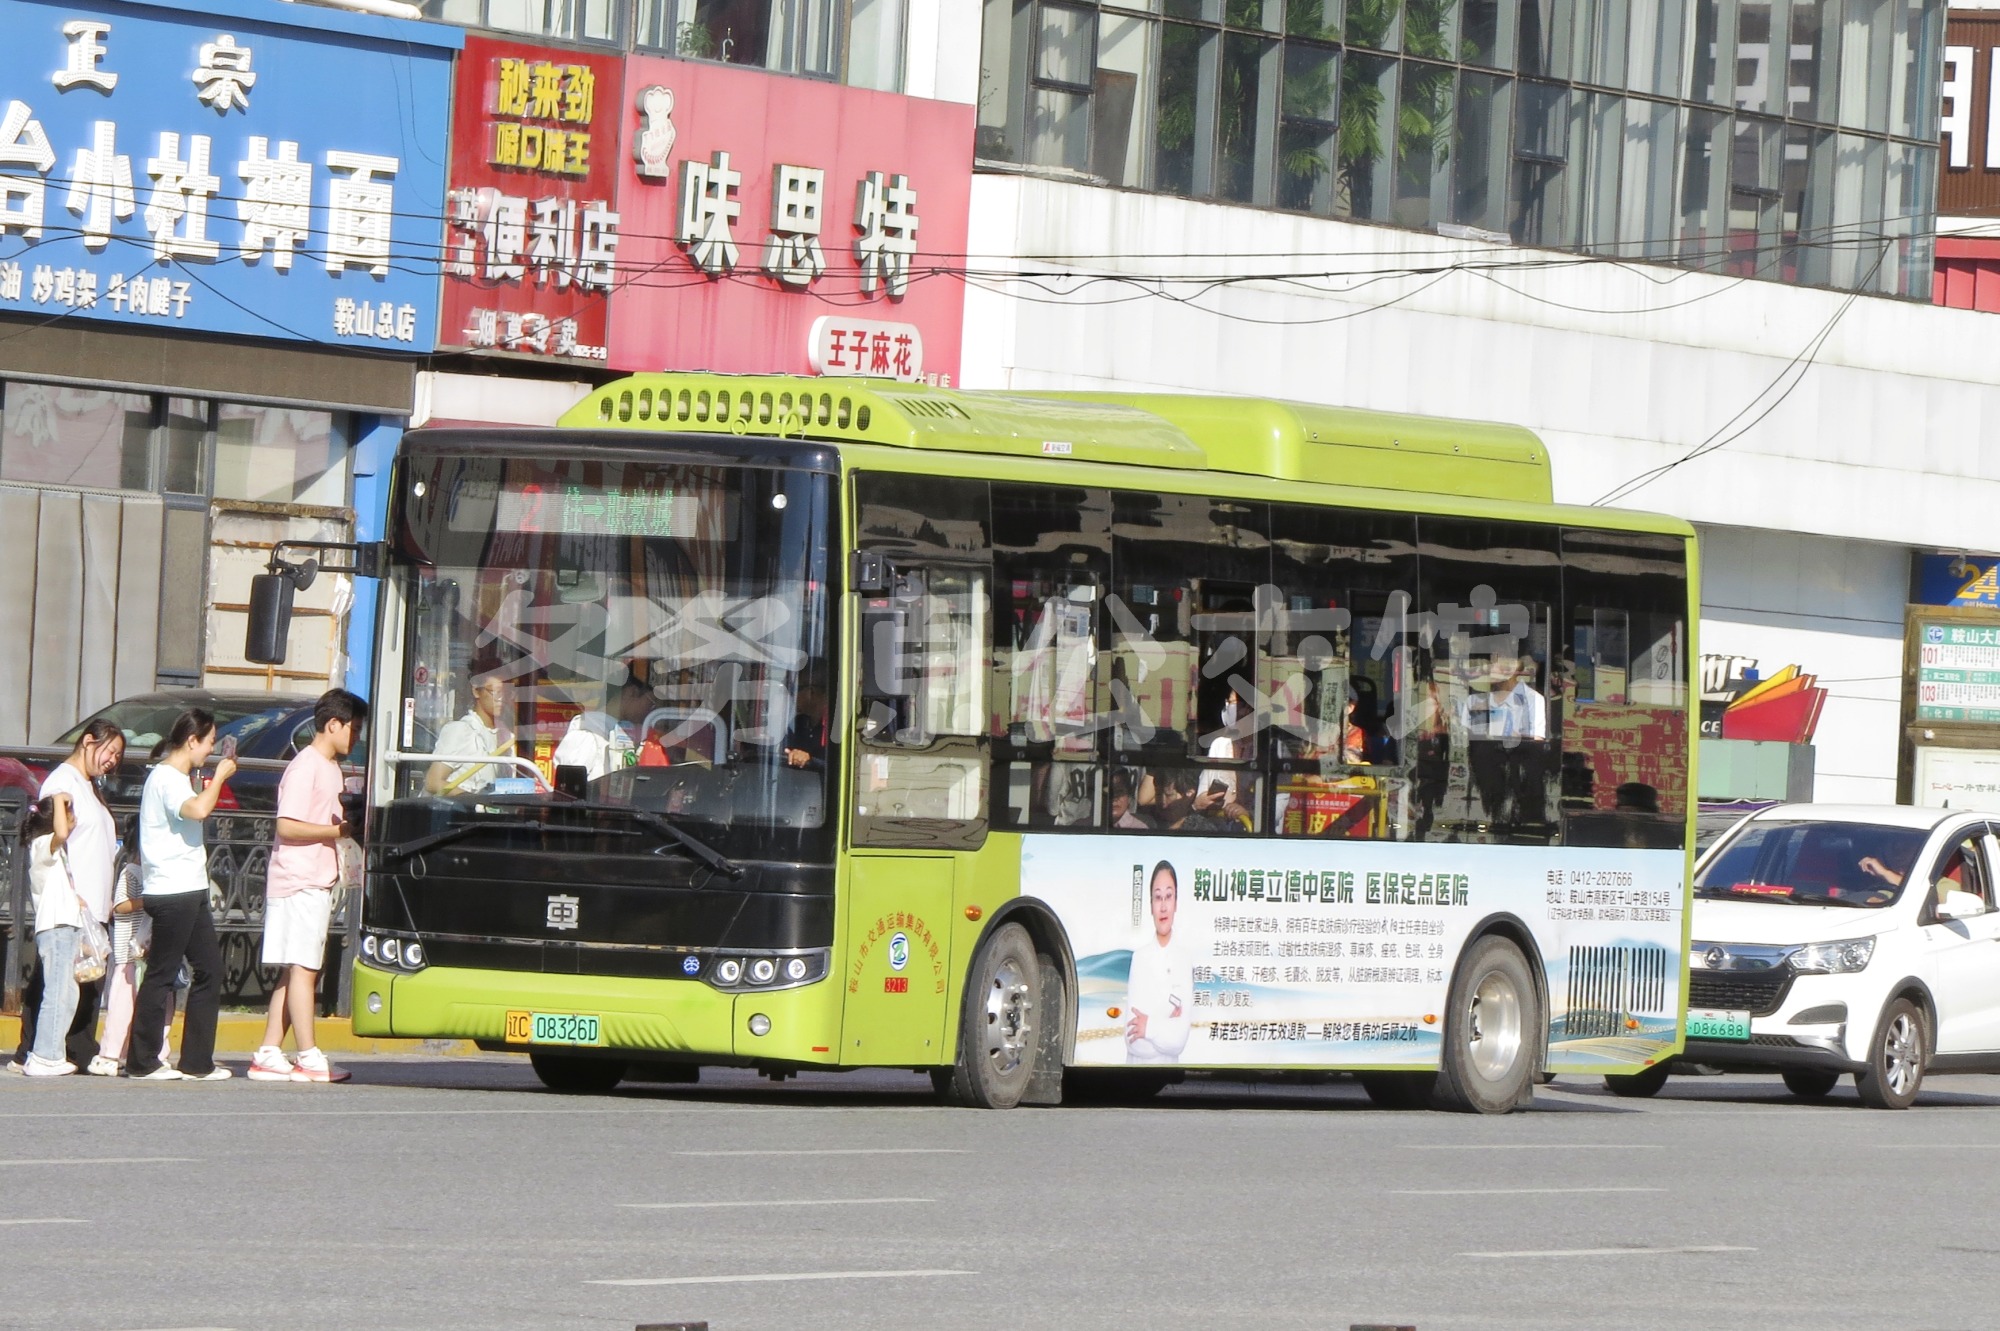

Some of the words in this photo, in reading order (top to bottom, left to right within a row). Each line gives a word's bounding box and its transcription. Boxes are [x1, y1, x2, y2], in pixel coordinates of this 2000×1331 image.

[52, 21, 257, 110] 正宗
[498, 57, 595, 125] 秒来劲
[482, 187, 621, 292] 便利店
[676, 150, 920, 297] 味思特
[32, 264, 97, 309] 炒鸡架
[107, 273, 192, 318] 牛肉腱子
[333, 297, 416, 342] 鞍山总店
[474, 308, 578, 356] 烟草专卖
[827, 329, 912, 377] 王子麻花
[519, 484, 543, 532] 2
[1955, 563, 1999, 601] 24
[1922, 646, 1939, 665] 101
[1920, 685, 1937, 703] 103
[1193, 868, 1355, 904] 鞍山神草立德中医院
[1366, 872, 1470, 907] 医保定点医院
[885, 979, 907, 992] 3213
[508, 1015, 529, 1038] 辽C
[536, 1017, 598, 1041] 08326D
